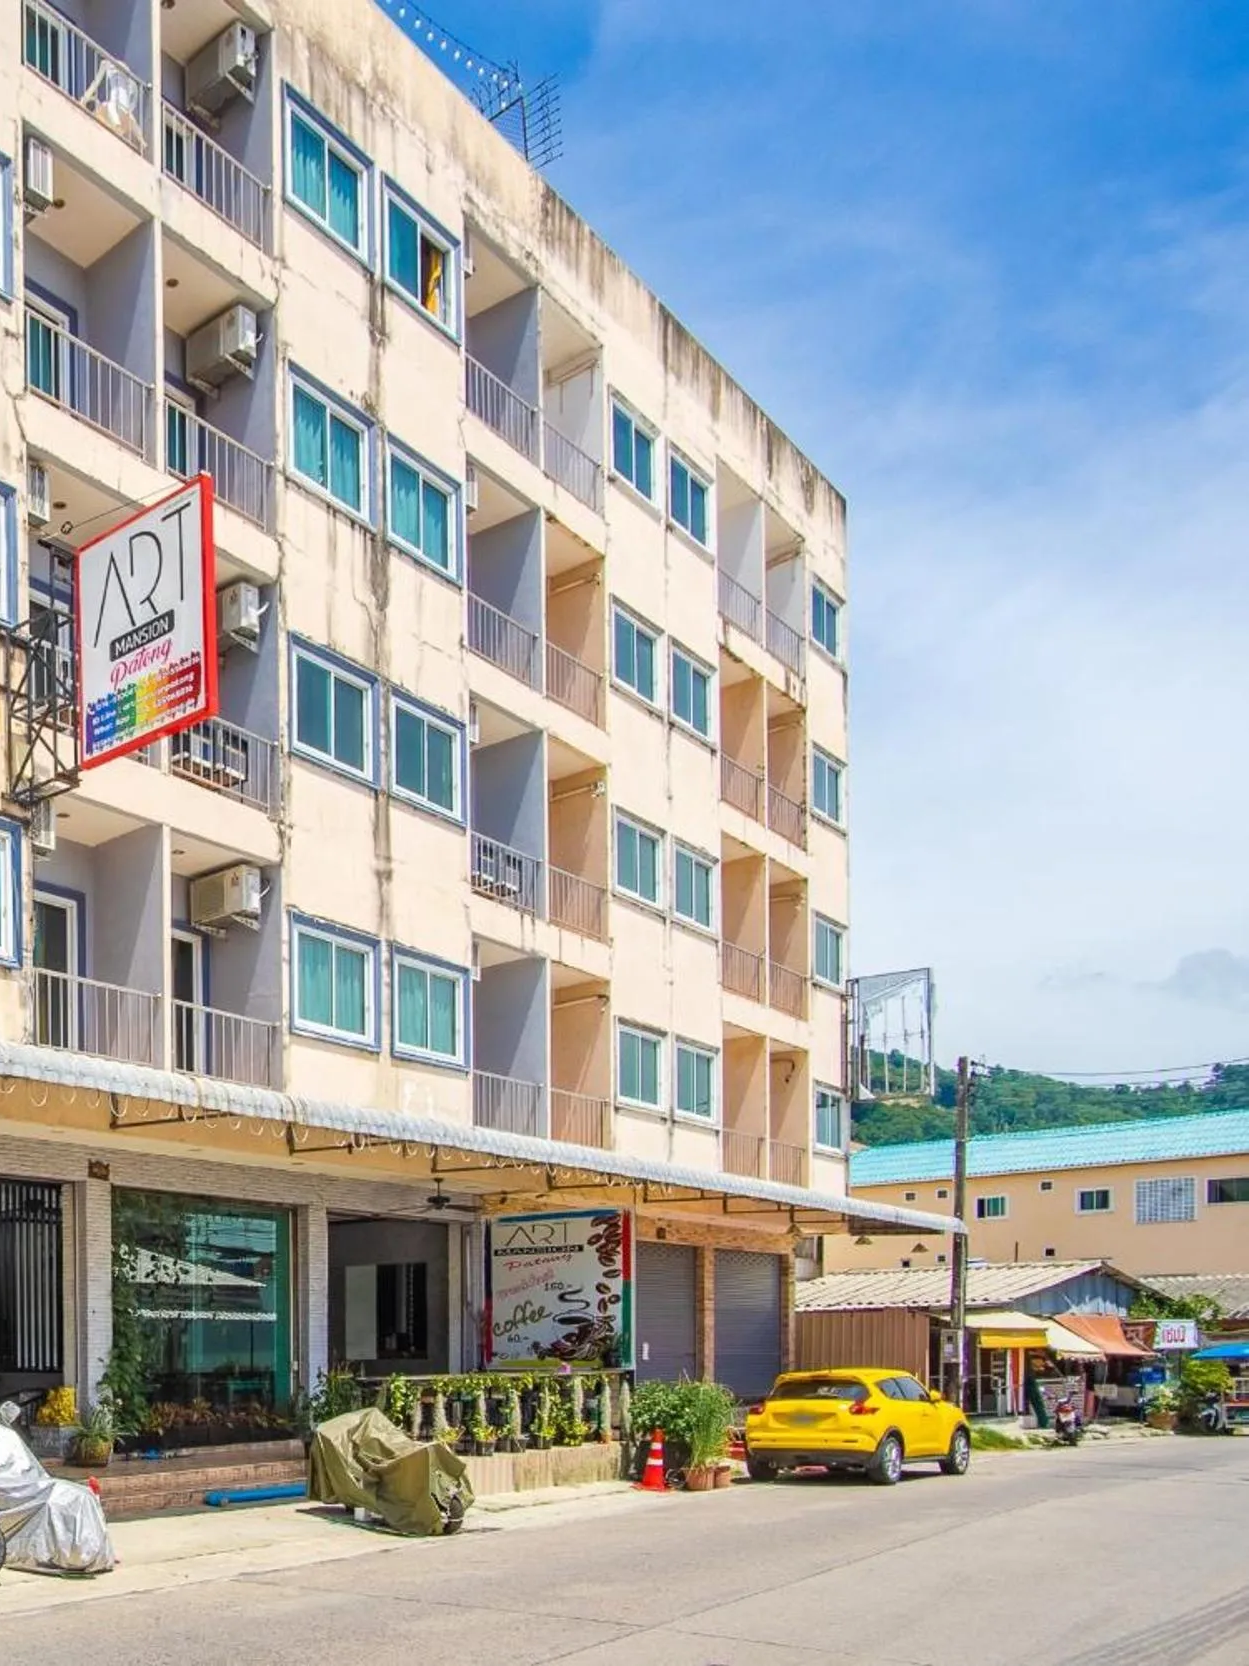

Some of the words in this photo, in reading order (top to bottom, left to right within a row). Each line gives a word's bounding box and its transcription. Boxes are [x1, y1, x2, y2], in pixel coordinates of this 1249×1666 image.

[94, 502, 191, 648] ART
[113, 616, 169, 657] MANSION
[110, 637, 173, 691] Patong
[506, 1222, 571, 1246] ART
[493, 1300, 553, 1337] coffee
